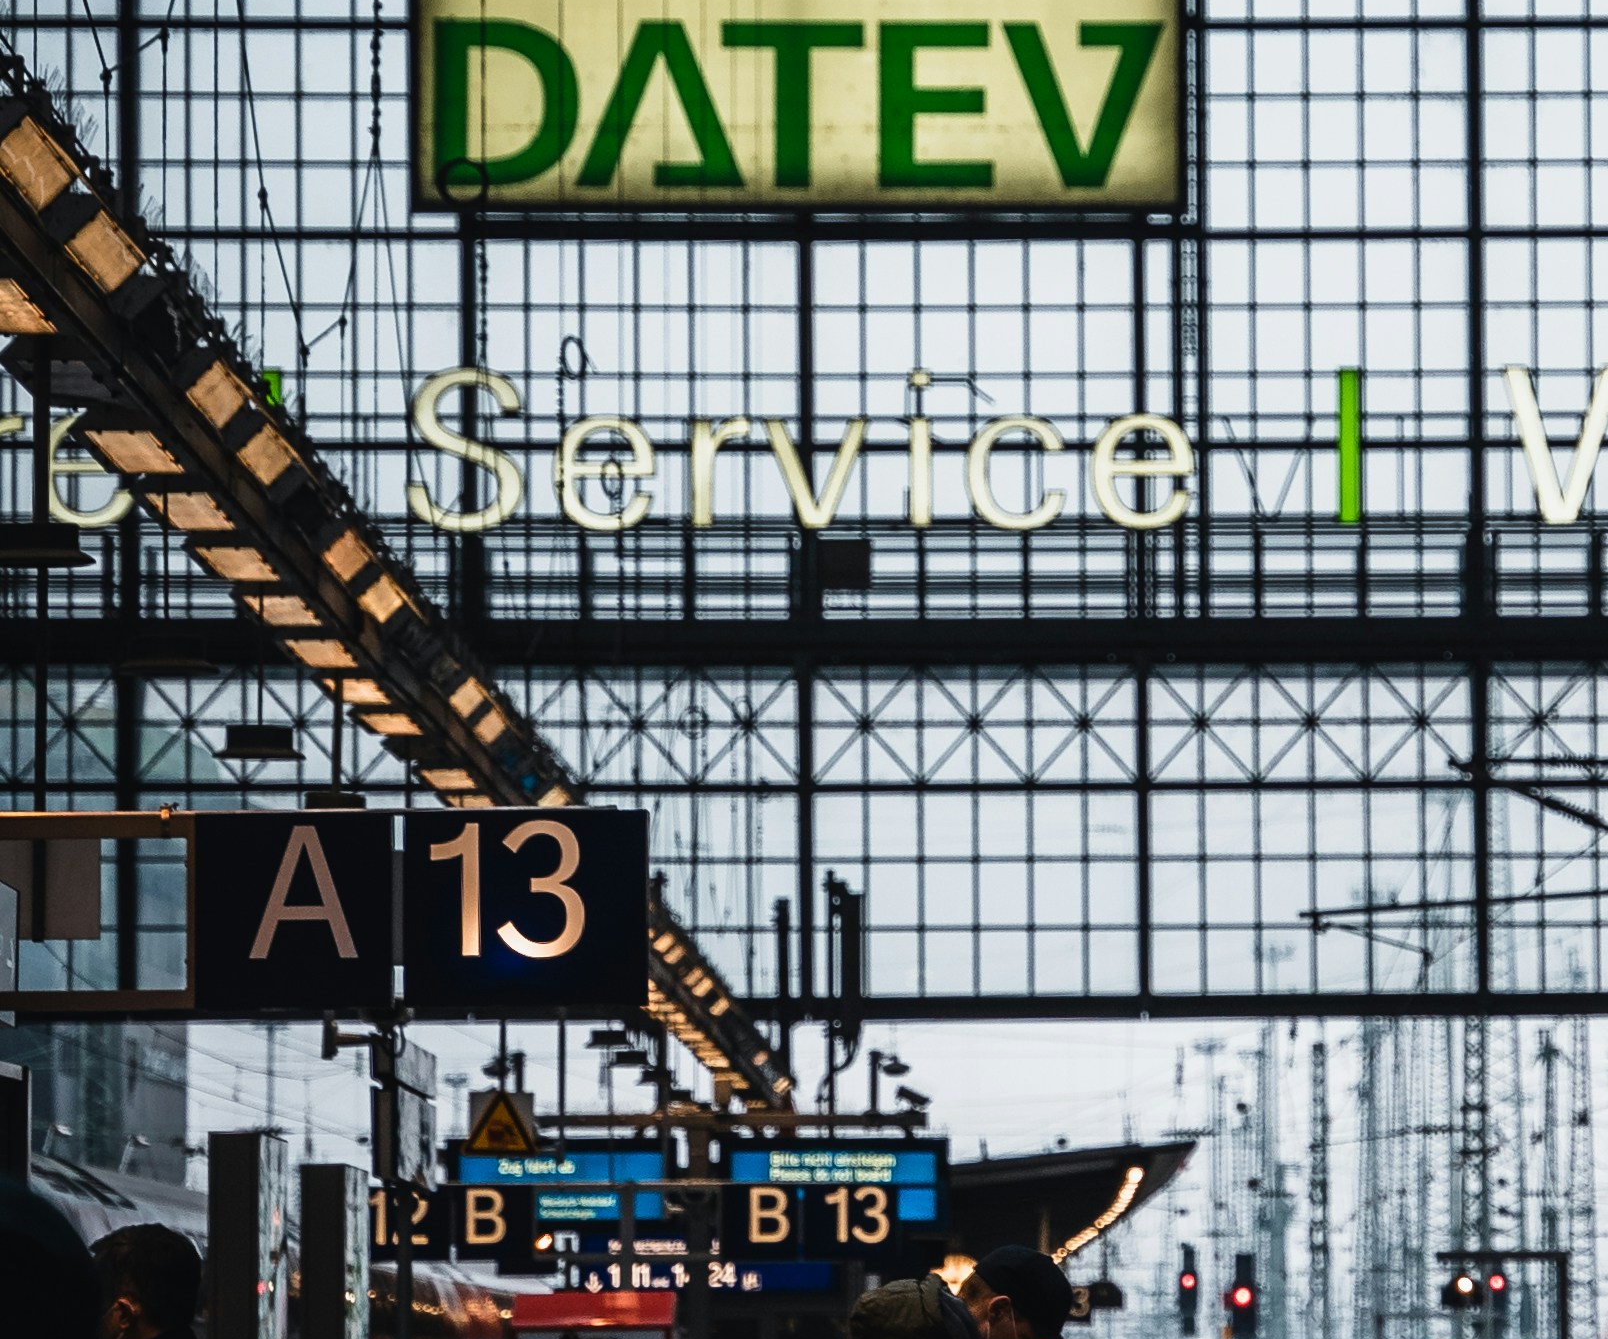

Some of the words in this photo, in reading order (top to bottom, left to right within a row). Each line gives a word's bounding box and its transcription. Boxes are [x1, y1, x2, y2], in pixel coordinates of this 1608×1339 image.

[433, 17, 1164, 189] DATEV
[406, 365, 1195, 532] Service
[248, 824, 359, 960] A
[428, 819, 586, 959] 13
[465, 1188, 507, 1245] B
[748, 1186, 791, 1244] B
[824, 1185, 891, 1245] 13
